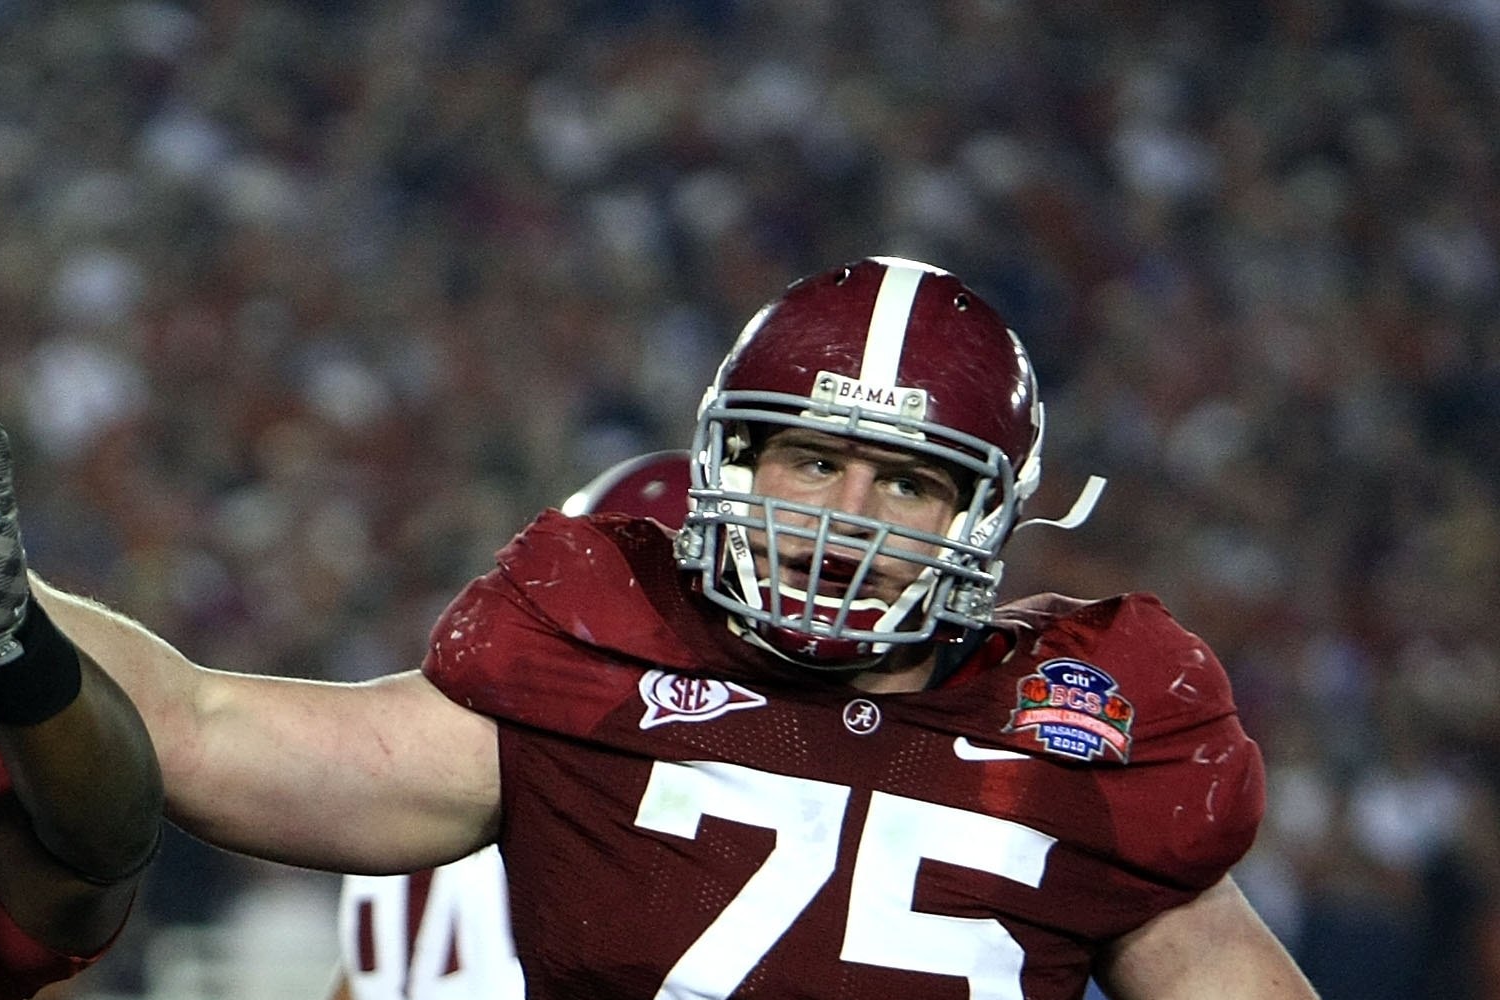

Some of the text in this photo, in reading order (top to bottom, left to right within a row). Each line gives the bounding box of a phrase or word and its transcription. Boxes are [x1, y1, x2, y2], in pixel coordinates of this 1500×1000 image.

[839, 381, 897, 407] BAMA
[668, 674, 712, 711] SEC
[1048, 684, 1102, 715] BCS
[1043, 724, 1099, 746] PASADENA
[1052, 735, 1086, 753] 2010
